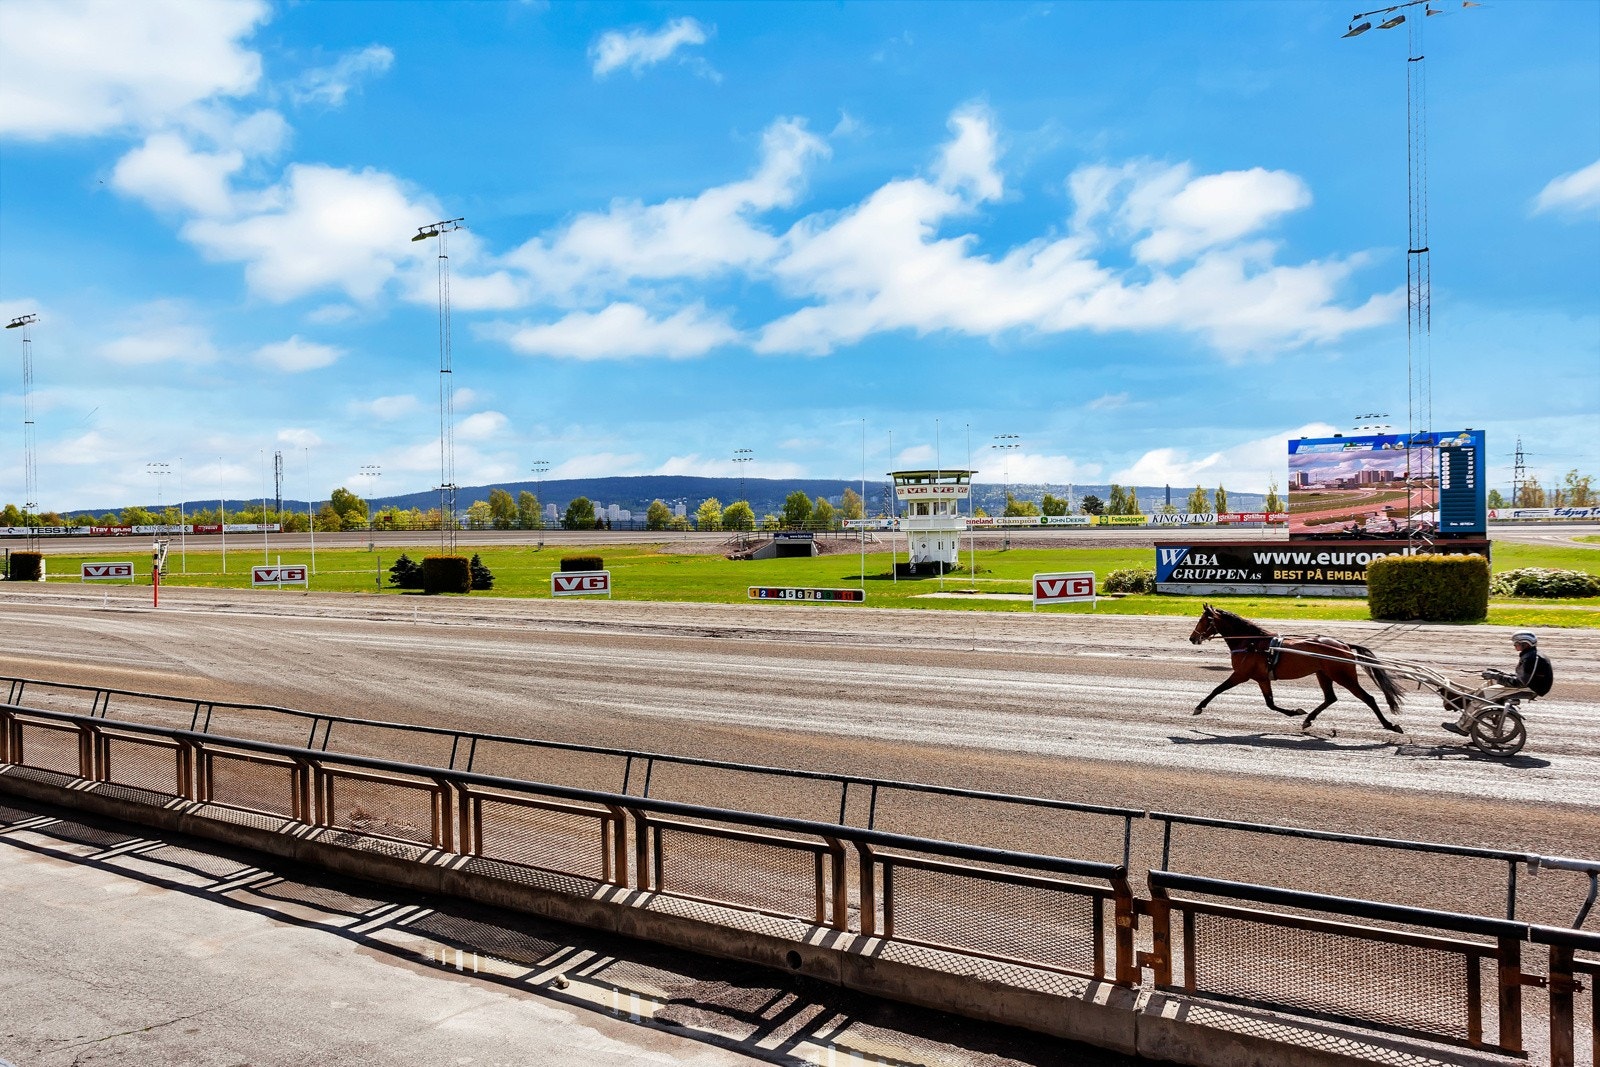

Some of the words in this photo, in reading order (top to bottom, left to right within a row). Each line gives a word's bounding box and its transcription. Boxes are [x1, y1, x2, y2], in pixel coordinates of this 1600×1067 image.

[996, 517, 1037, 526] Champion
[1152, 514, 1214, 523] KINGSLAND
[1159, 548, 1220, 566] WABA
[85, 566, 129, 576] VG
[257, 568, 305, 581] VG
[1172, 568, 1249, 580] GRUPPEN
[1273, 570, 1303, 580] BEST
[1307, 569, 1323, 580] PÅ
[556, 576, 605, 590] VG
[1038, 579, 1090, 597] VG
[779, 590, 784, 598] 4
[788, 590, 794, 598] 5
[797, 590, 803, 598] 6
[816, 591, 822, 599] 8
